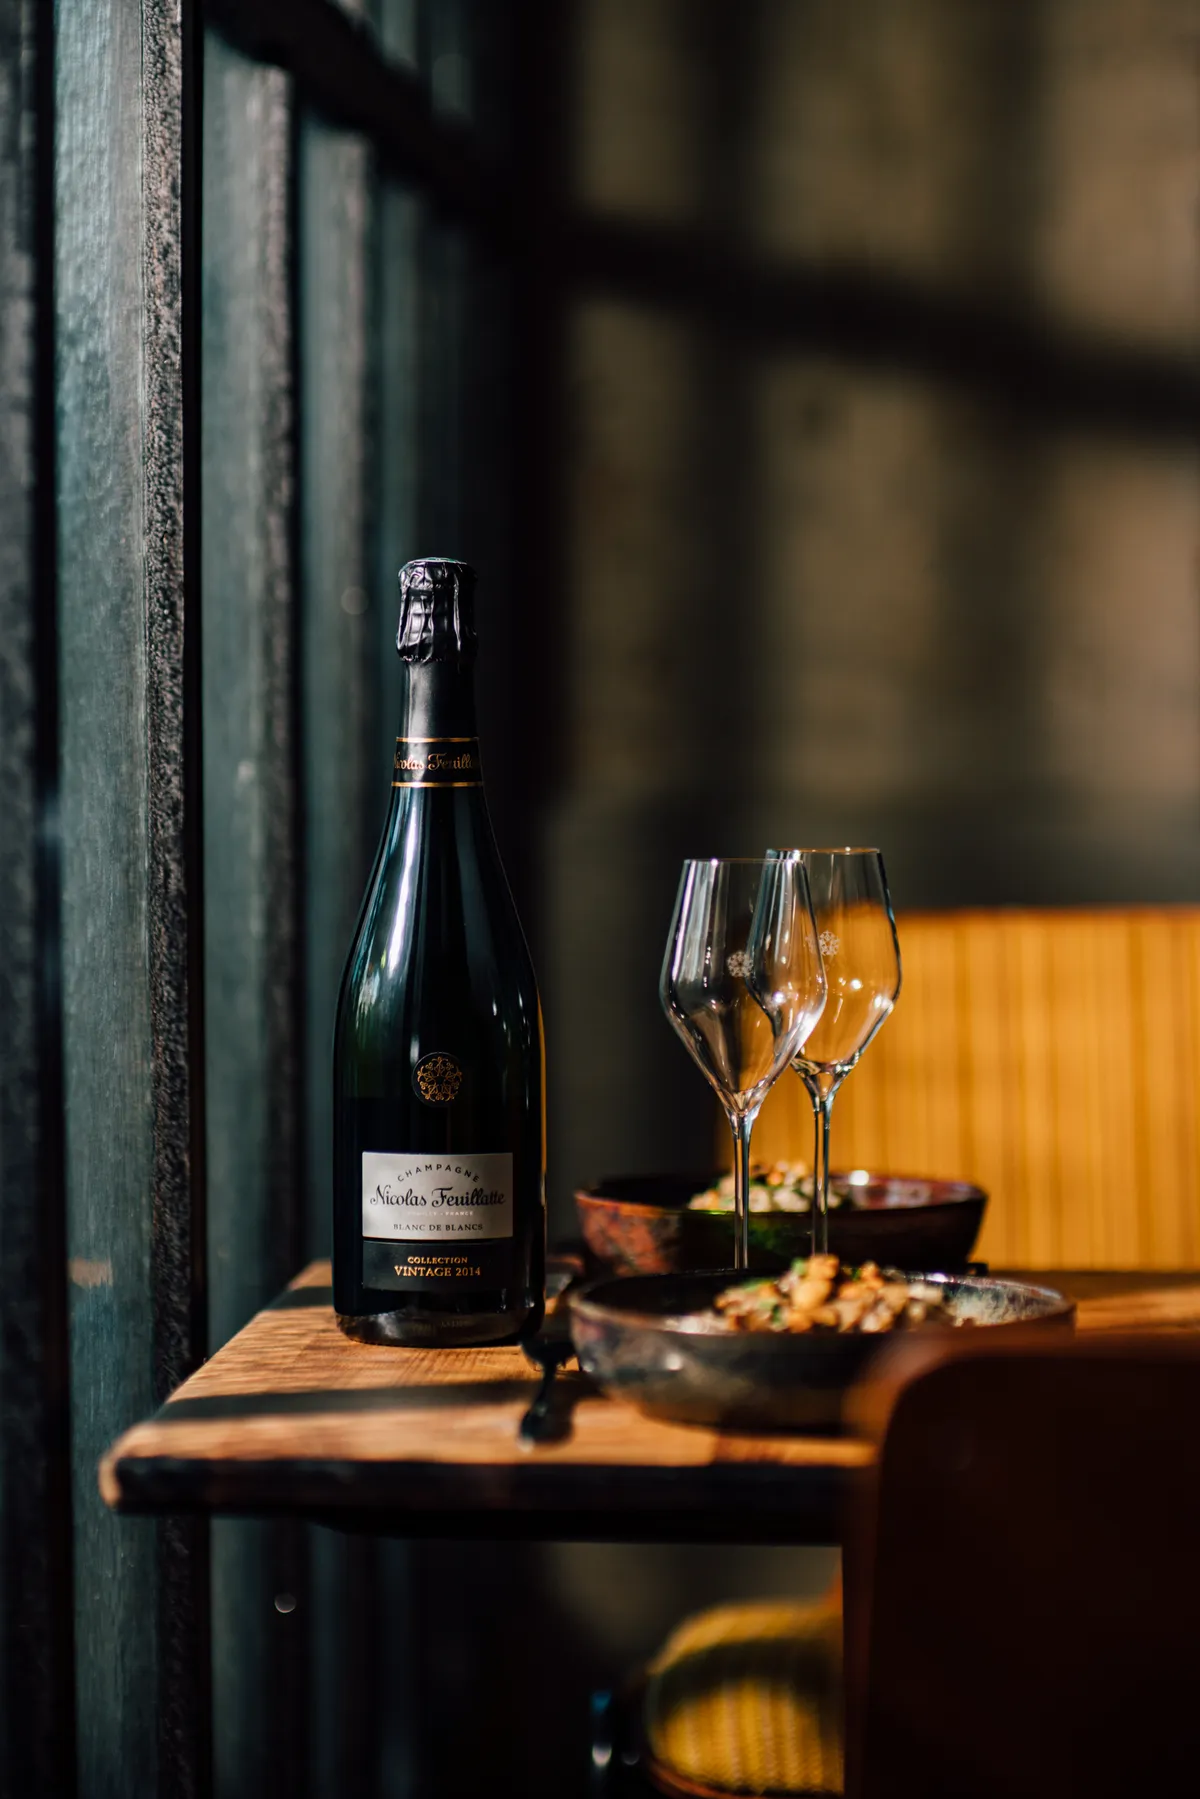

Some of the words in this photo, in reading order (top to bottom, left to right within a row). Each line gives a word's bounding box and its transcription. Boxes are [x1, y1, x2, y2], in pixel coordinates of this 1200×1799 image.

[397, 1163, 480, 1182] CHAMPAGNE
[370, 1184, 427, 1206] Nicolas
[431, 1186, 506, 1208] Feuillatte
[393, 1223, 426, 1231] BLANC
[445, 1223, 483, 1231] BLANCS
[407, 1256, 468, 1264] COLLECTION
[394, 1266, 452, 1277] VINTAGE
[455, 1266, 481, 1276] 2014
